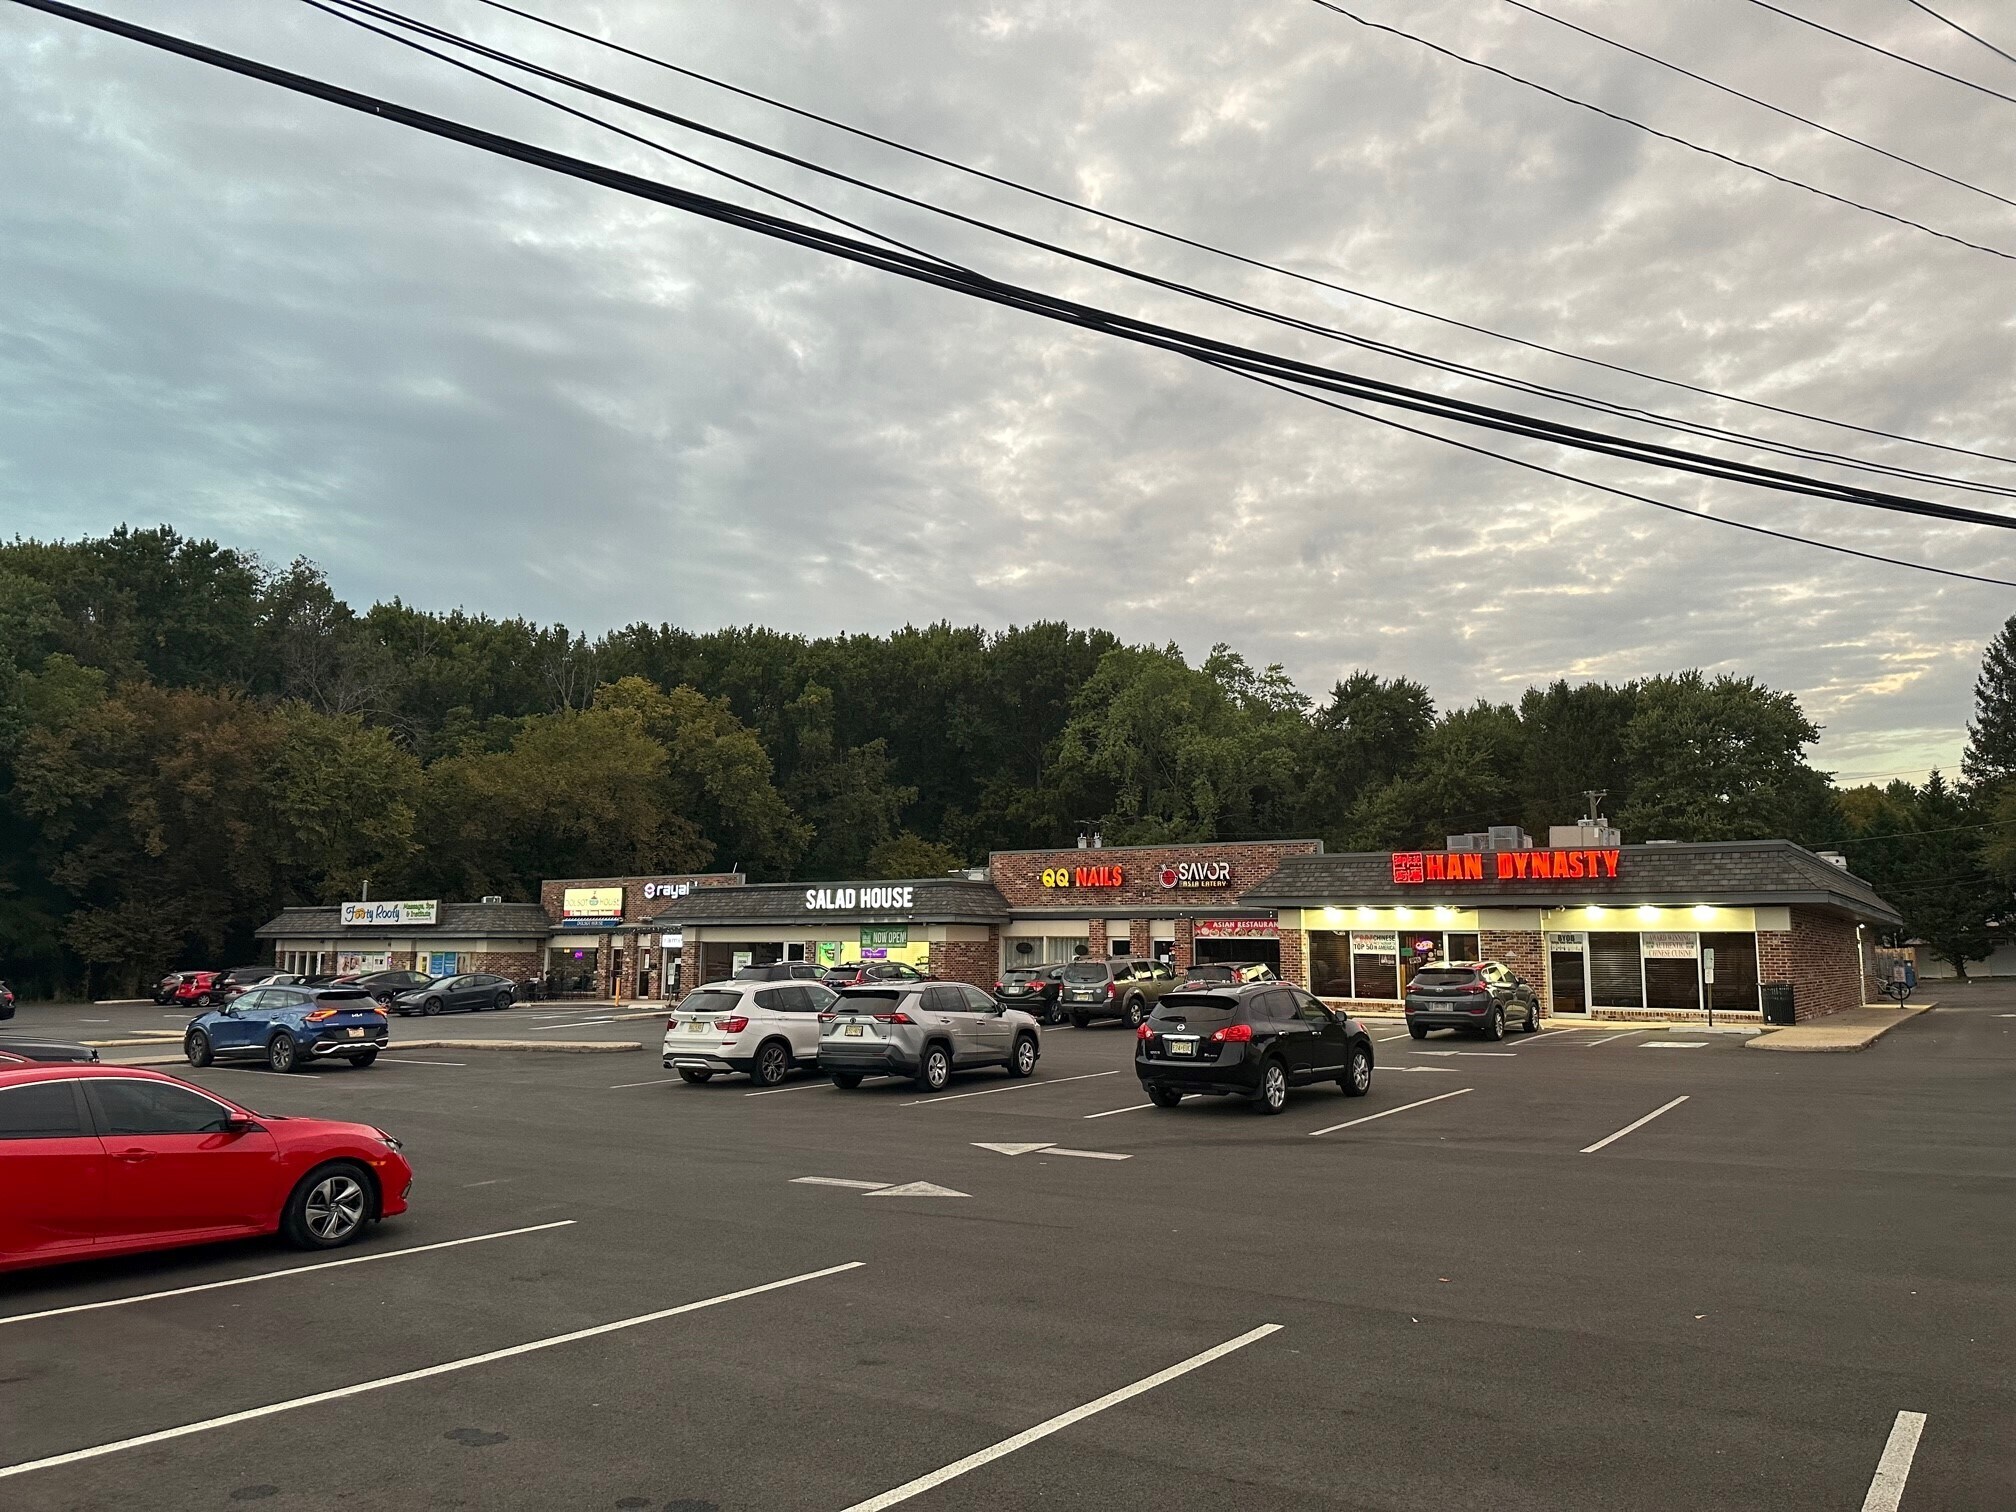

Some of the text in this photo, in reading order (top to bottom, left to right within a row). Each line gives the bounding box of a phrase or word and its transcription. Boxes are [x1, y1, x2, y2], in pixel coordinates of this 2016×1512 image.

[1179, 862, 1230, 880] SAVOR
[1426, 854, 1483, 880] HAN
[1497, 850, 1619, 879] DYNASTY
[1042, 866, 1122, 887] QQ NAILS
[806, 887, 914, 909] SALAD HOUSE
[873, 931, 887, 943] NOW
[888, 931, 907, 943] OPEN!
[1373, 934, 1395, 942] CHINESE
[1557, 934, 1575, 942] BYOB
[1655, 941, 1684, 949] AUTHENTIC
[1649, 949, 1671, 957] CHINESE
